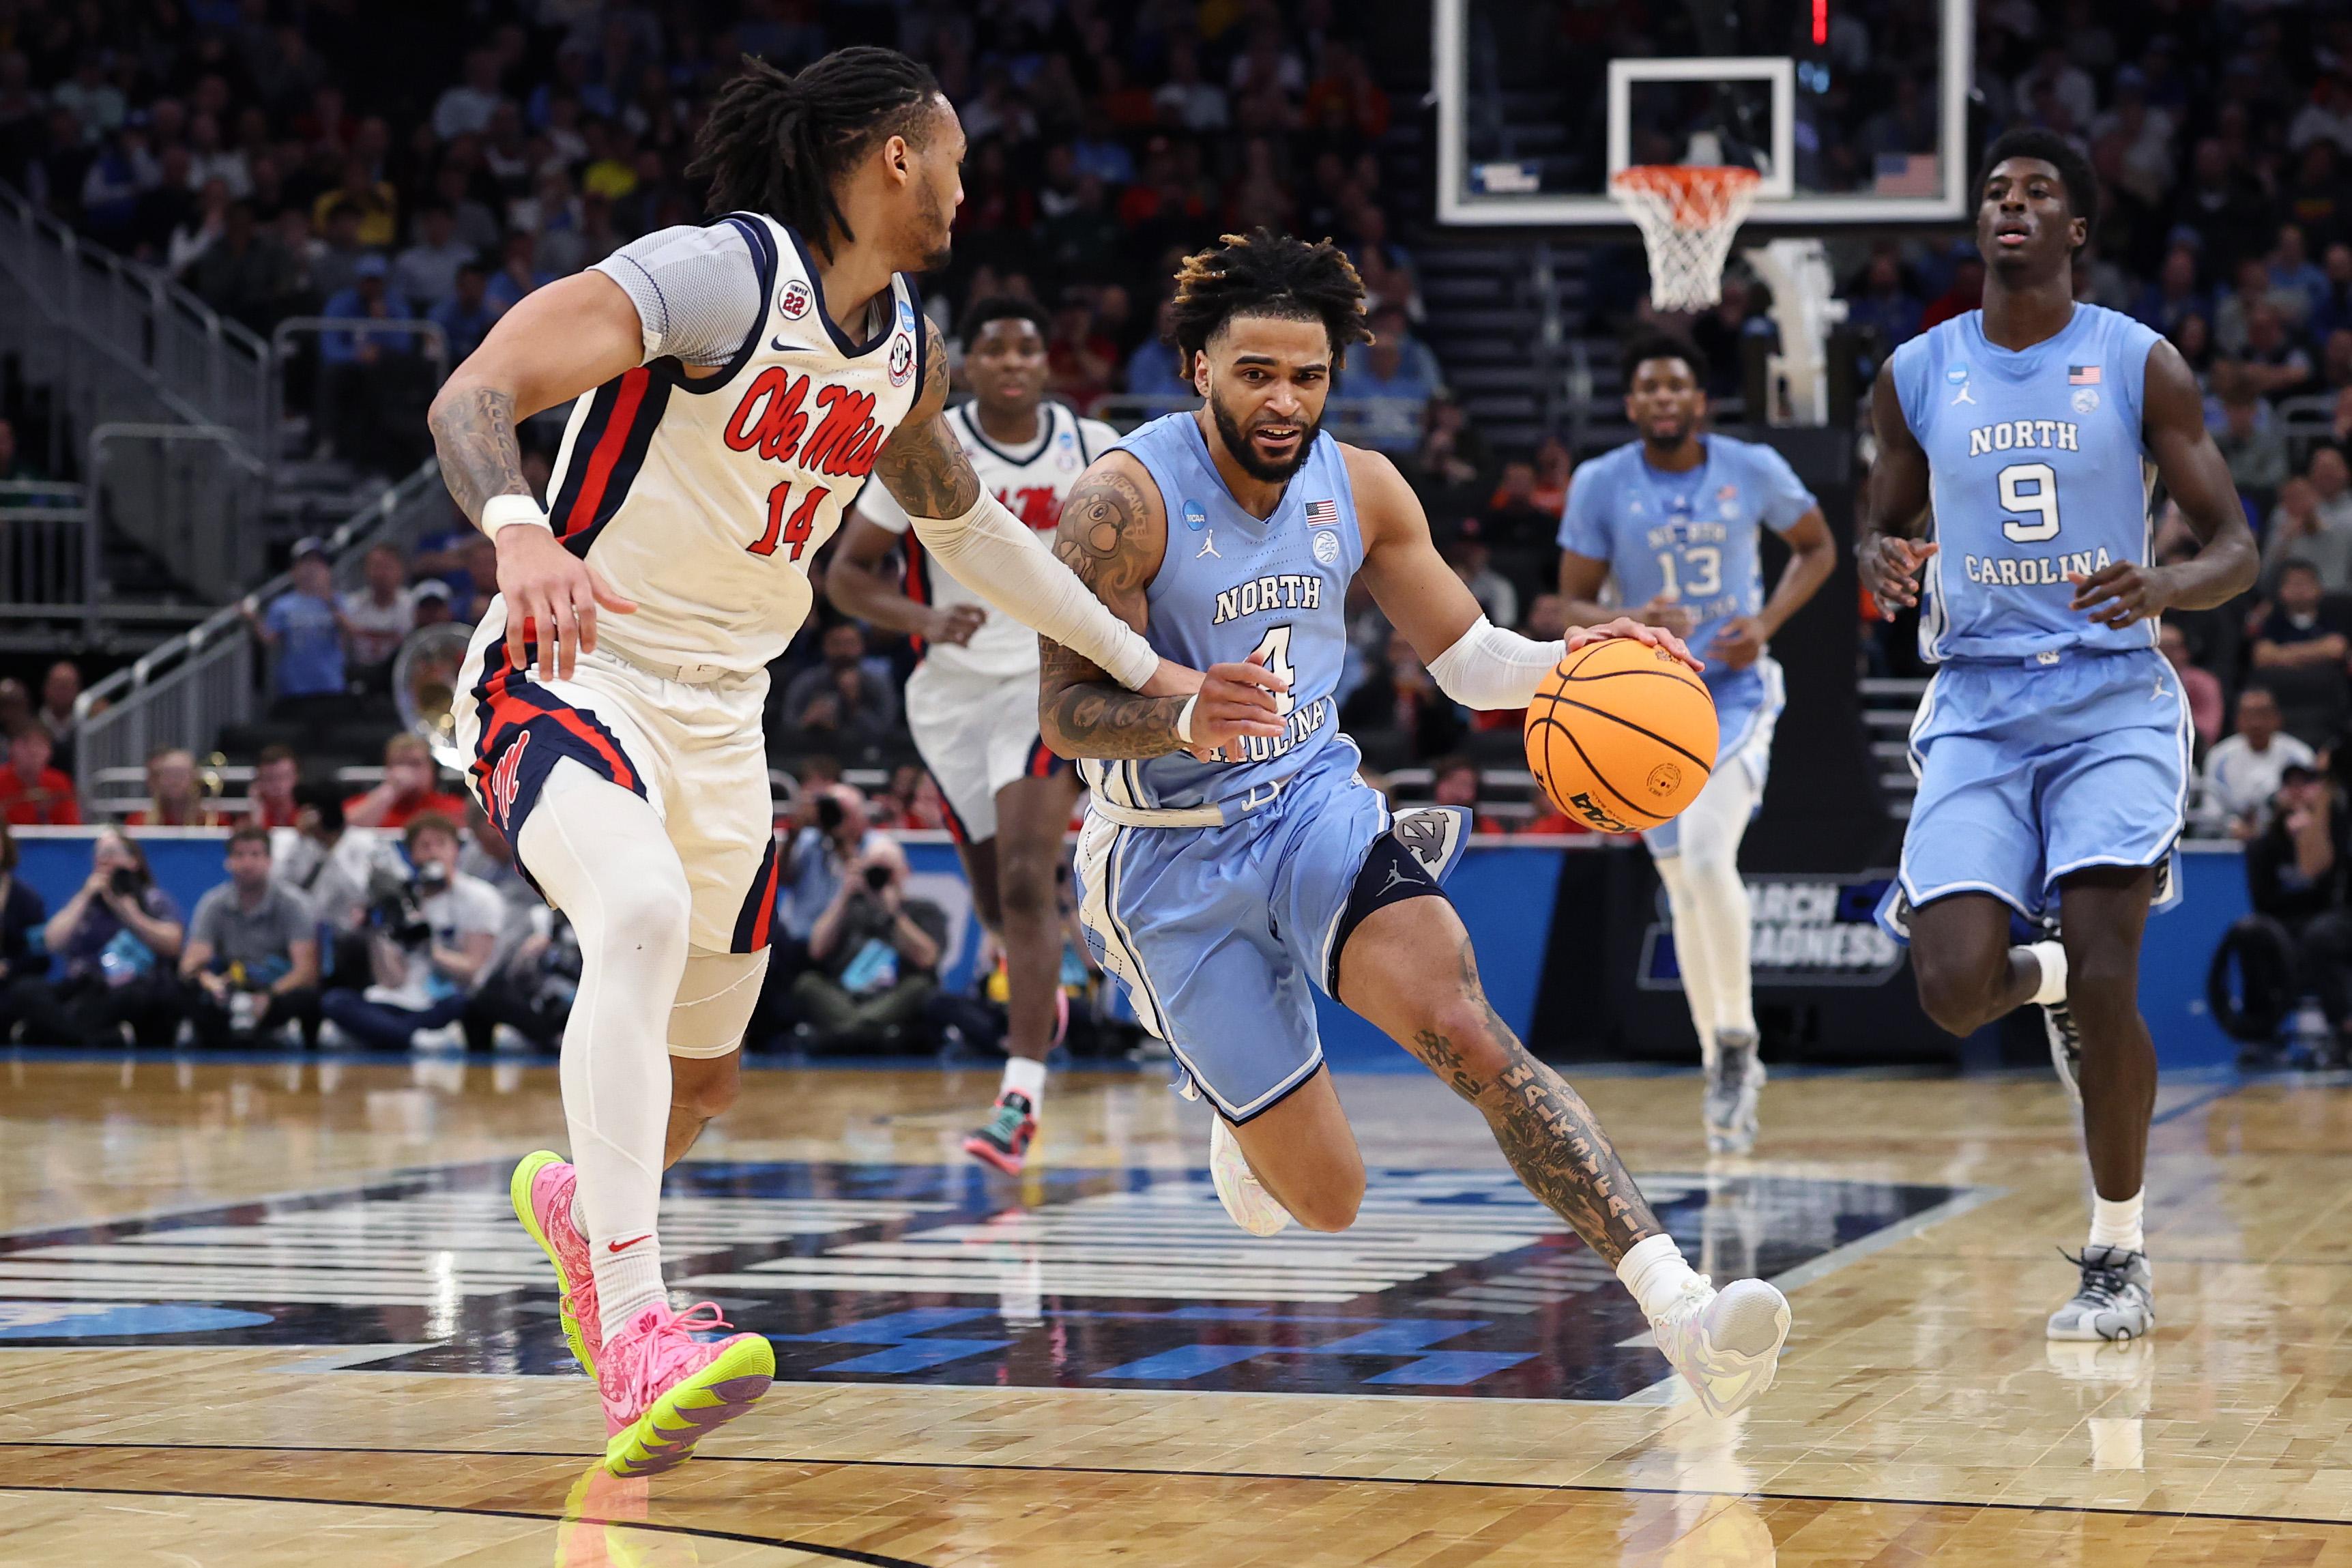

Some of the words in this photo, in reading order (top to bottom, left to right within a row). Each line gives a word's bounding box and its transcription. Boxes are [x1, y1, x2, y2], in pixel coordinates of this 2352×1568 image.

[783, 292, 805, 316] 22
[723, 366, 810, 463] Ole
[1969, 419, 2080, 458] NORTH
[746, 480, 831, 562] 14
[1186, 514, 1205, 523] NCAA
[1997, 462, 2061, 544] 9
[1657, 547, 1722, 600] 13
[1964, 546, 2112, 586] CAROLINA
[1212, 574, 1321, 626] NORTH
[1243, 624, 1295, 716] 4
[1210, 700, 1327, 764] OLINA
[1569, 792, 1638, 832] CAA
[1745, 883, 1840, 922] ARCH
[1751, 923, 1898, 967] ADNESS
[1501, 1062, 1577, 1138] WALK
[1570, 1137, 1599, 1175] BY
[1593, 1173, 1649, 1243] FAIT
